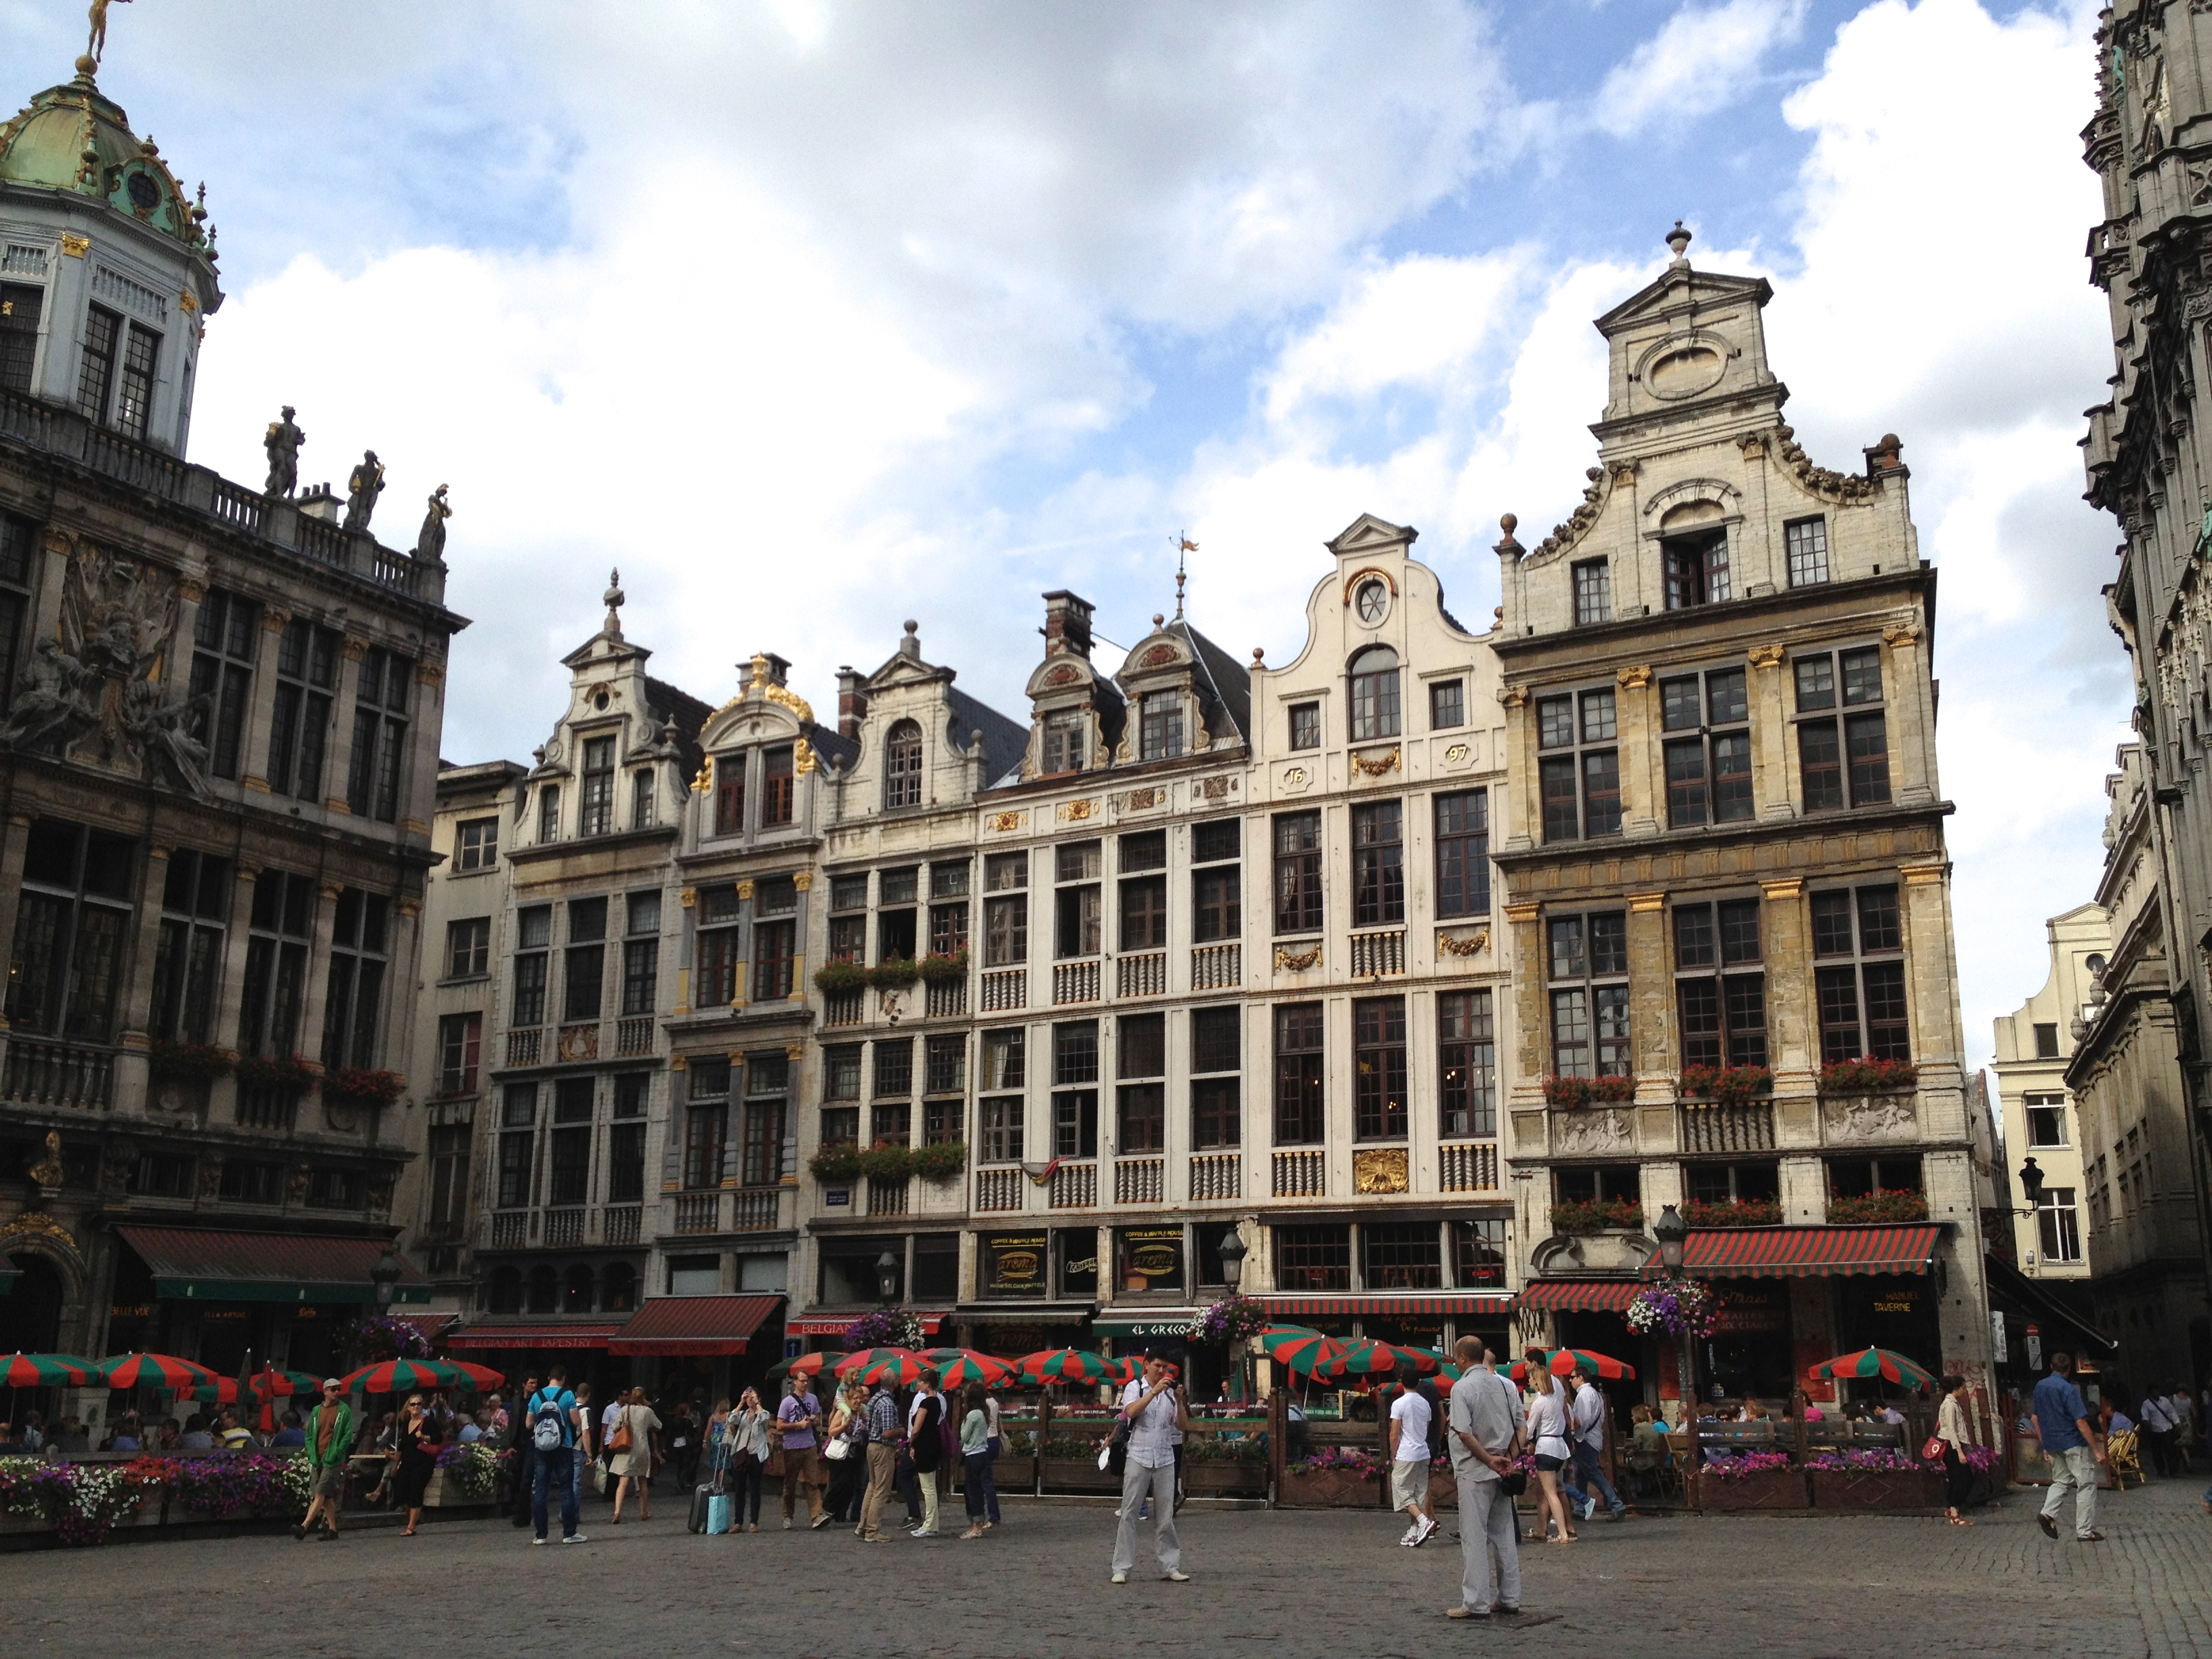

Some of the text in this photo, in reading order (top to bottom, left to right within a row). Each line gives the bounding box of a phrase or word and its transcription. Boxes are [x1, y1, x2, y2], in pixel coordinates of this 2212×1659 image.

[1450, 747, 1467, 761] 97
[1290, 769, 1303, 783] 16
[998, 1258, 1038, 1271] aroma
[1132, 1253, 1174, 1266] aroma
[1885, 1290, 1920, 1300] MANUEL
[1872, 1302, 1911, 1312] TAVERNE
[1723, 1312, 1765, 1320] SALLES
[1132, 1324, 1187, 1335] EL GRECO
[1716, 1322, 1735, 1330] AUX
[465, 1337, 592, 1347] BELGIAN ART TAPESTRY
